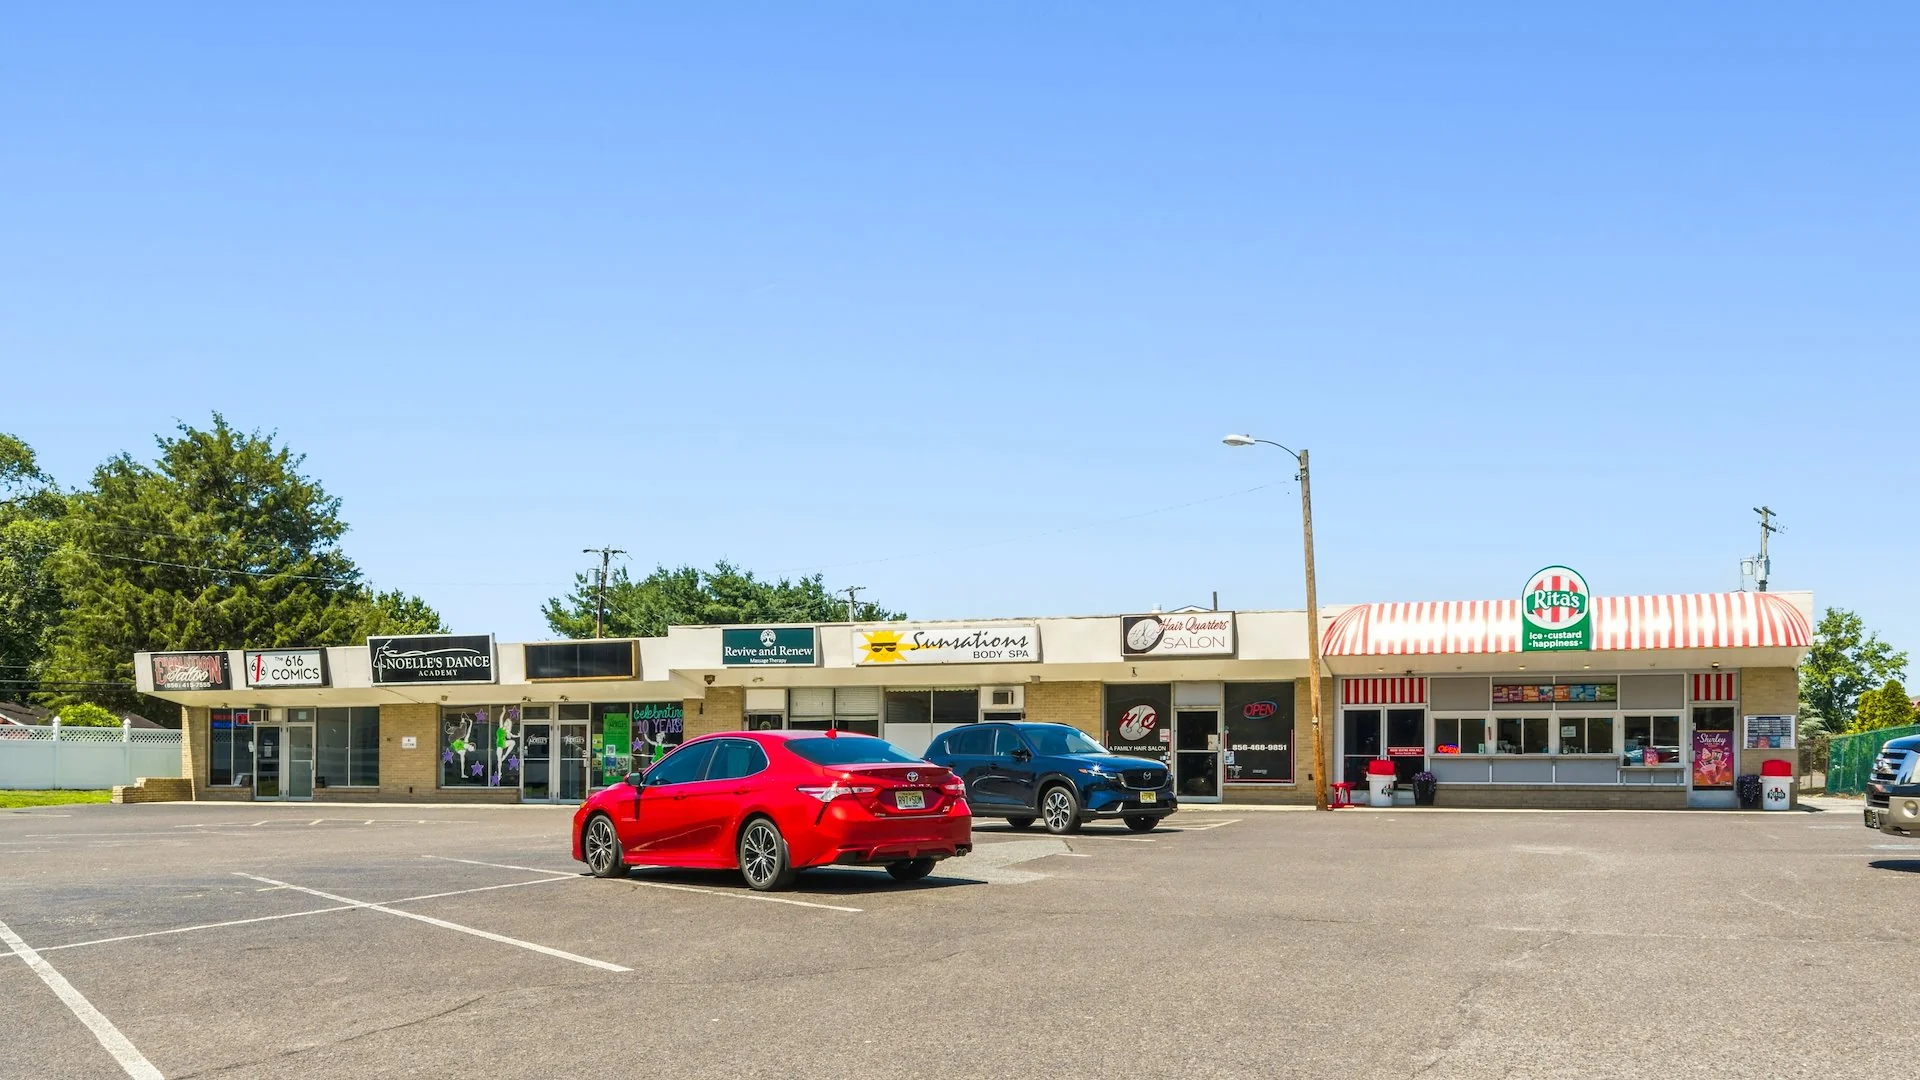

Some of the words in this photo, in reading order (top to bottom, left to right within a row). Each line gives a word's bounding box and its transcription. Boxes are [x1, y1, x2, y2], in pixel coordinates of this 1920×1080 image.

[1534, 589, 1580, 610] Rita's
[1157, 617, 1183, 633] Hair
[1185, 616, 1229, 634] Quarters
[910, 630, 1029, 651] Sunsations
[1529, 632, 1543, 640] ice
[1547, 630, 1582, 639] custard
[1162, 636, 1225, 649] SALON
[1532, 640, 1579, 648] happiness
[724, 646, 757, 657] Revive
[758, 646, 777, 656] and
[778, 645, 813, 656] Renew
[973, 650, 1003, 659] BODY
[1008, 649, 1029, 658] SPA
[285, 655, 304, 667] 616
[386, 656, 443, 670] NOELLE'S
[445, 655, 490, 668] DANCE
[167, 664, 209, 682] Tattoo
[271, 667, 320, 681] COMICS
[418, 669, 458, 677] ACADEMY
[1243, 703, 1275, 717] OPEN
[637, 719, 649, 734] 10
[652, 718, 683, 733] YEARS
[1437, 744, 1459, 755] OPEN
